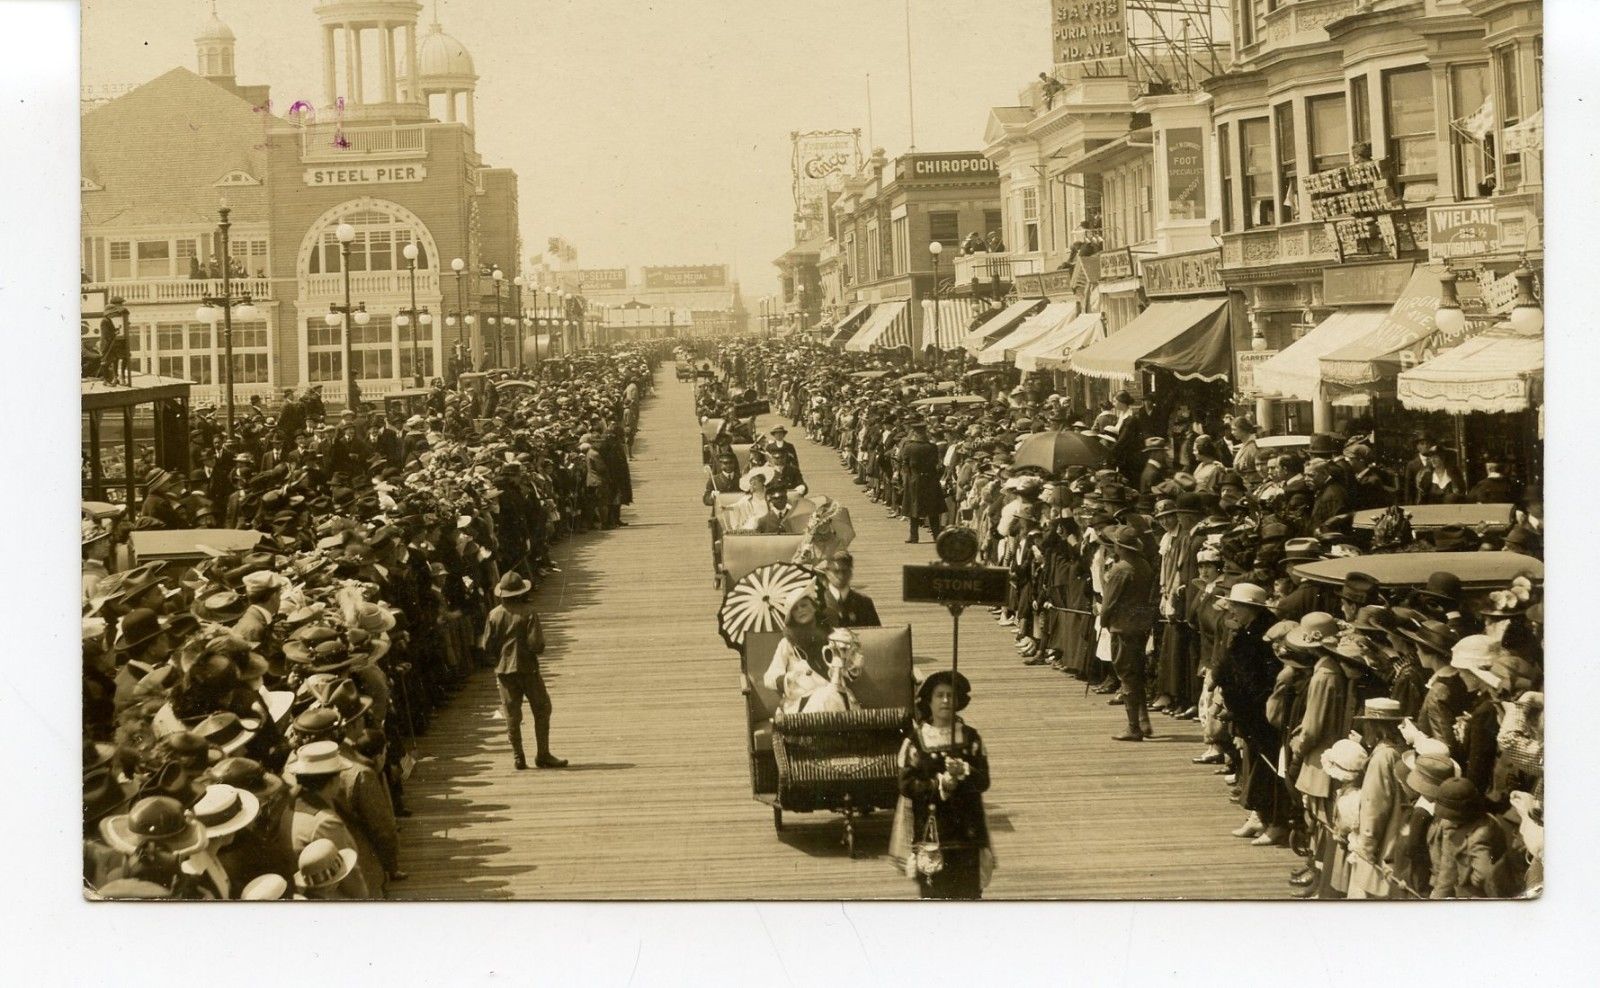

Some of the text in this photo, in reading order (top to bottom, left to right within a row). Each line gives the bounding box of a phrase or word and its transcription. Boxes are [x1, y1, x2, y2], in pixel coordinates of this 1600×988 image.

[1091, 22, 1122, 36] HALL
[1173, 156, 1198, 166] FOOT
[314, 167, 416, 183] STEEL PIER
[932, 578, 983, 591] STONE
